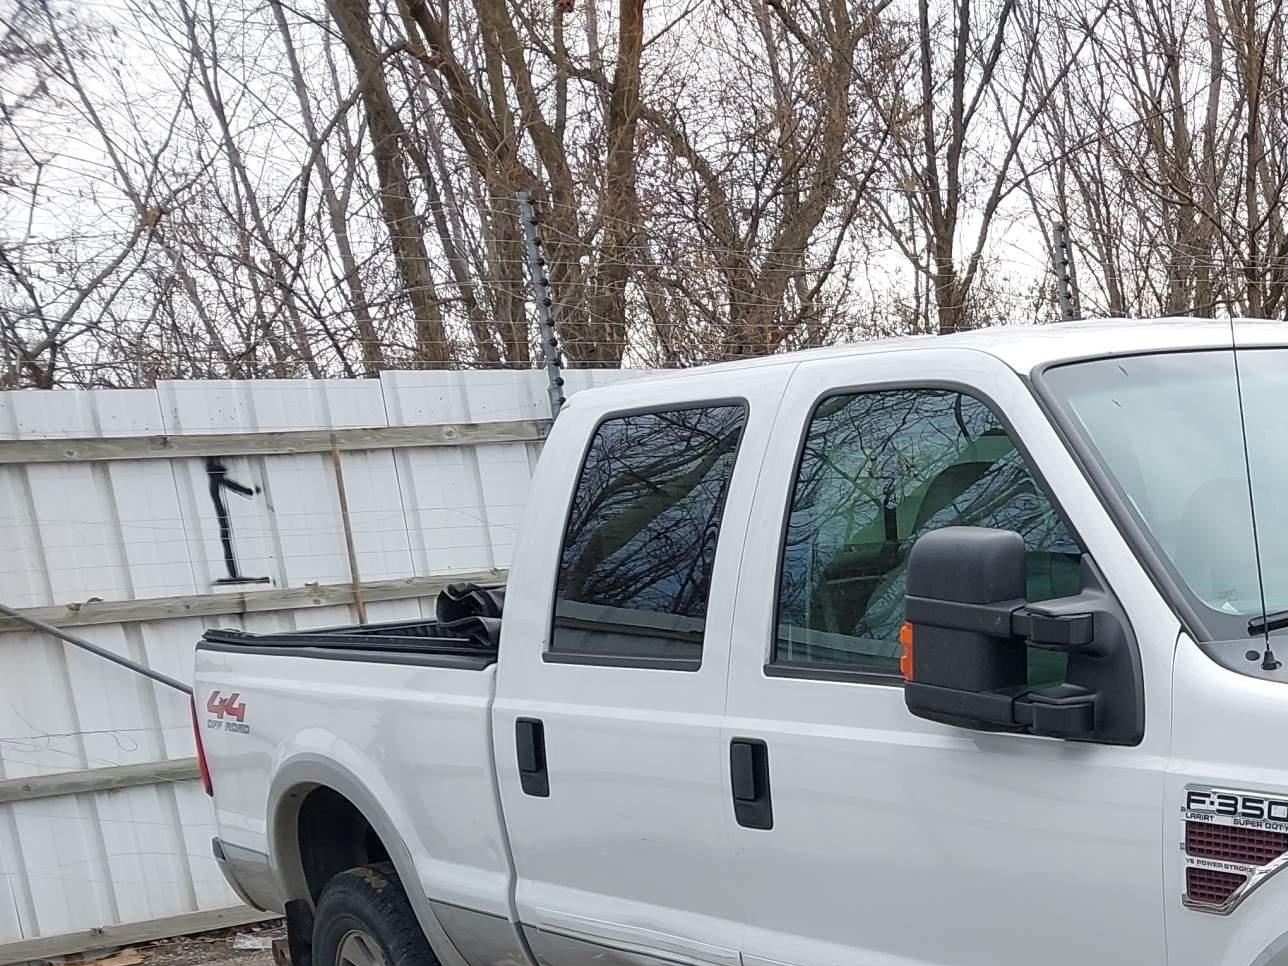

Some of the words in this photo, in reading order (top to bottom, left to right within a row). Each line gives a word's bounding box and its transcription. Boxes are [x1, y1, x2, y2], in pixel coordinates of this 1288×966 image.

[207, 719, 223, 729] OFF
[225, 721, 250, 735] ROAD
[1233, 818, 1263, 829] SUPER
[1196, 859, 1224, 868] POWER
[1224, 863, 1256, 873] STROKE
